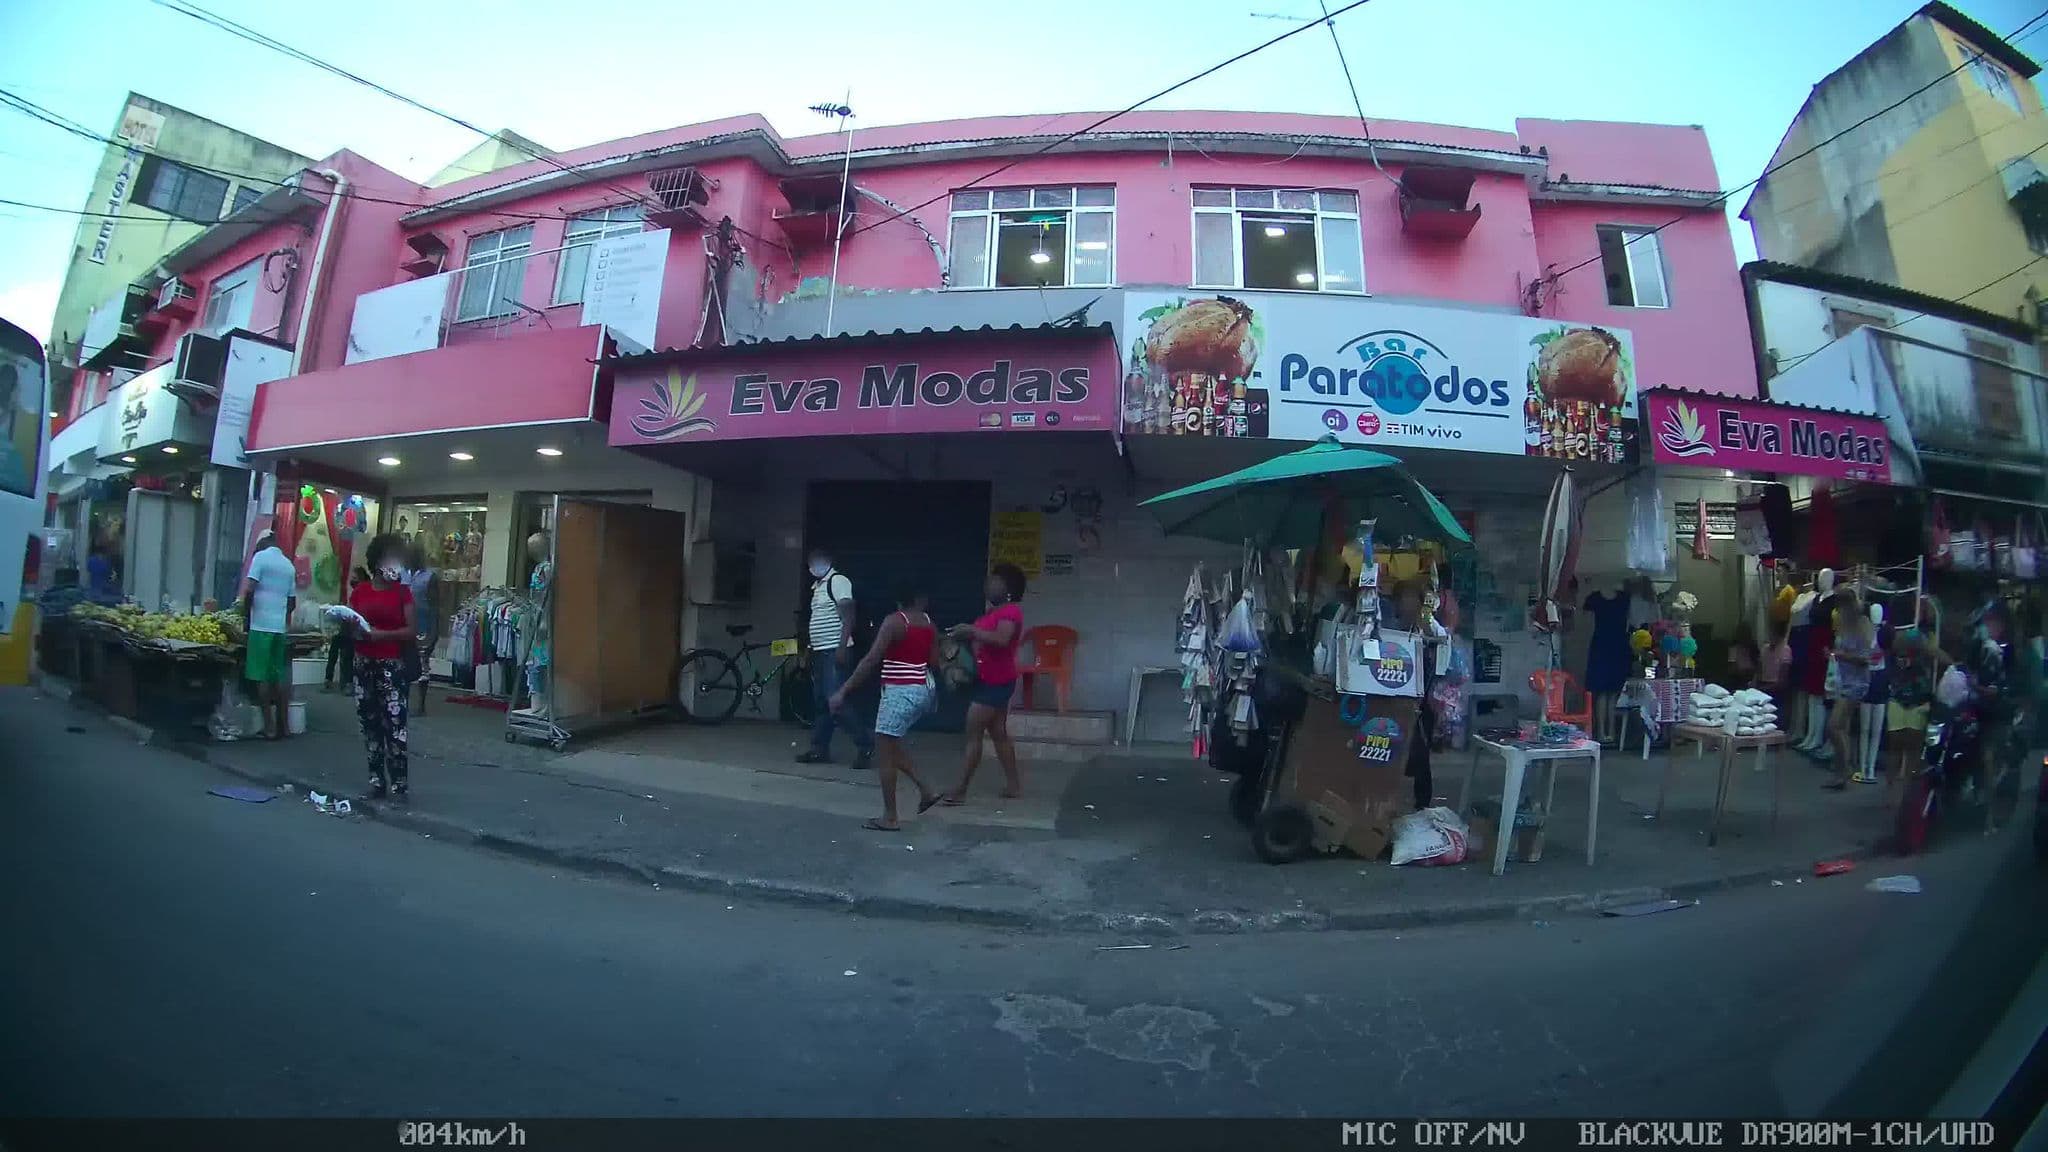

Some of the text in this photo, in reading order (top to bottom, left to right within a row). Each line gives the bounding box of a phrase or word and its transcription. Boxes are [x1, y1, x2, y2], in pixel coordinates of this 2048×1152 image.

[1356, 338, 1427, 363] Bar
[729, 360, 1090, 416] Eva Modas
[1280, 353, 1510, 407] Paratodos
[1400, 423, 1424, 436] TIM
[1427, 425, 1462, 439] vivo
[1717, 409, 1886, 467] Eva Modas
[1380, 658, 1404, 670] PIPO
[1377, 668, 1407, 682] 22221
[1366, 735, 1390, 749] PIPO
[1359, 746, 1391, 762] 22221
